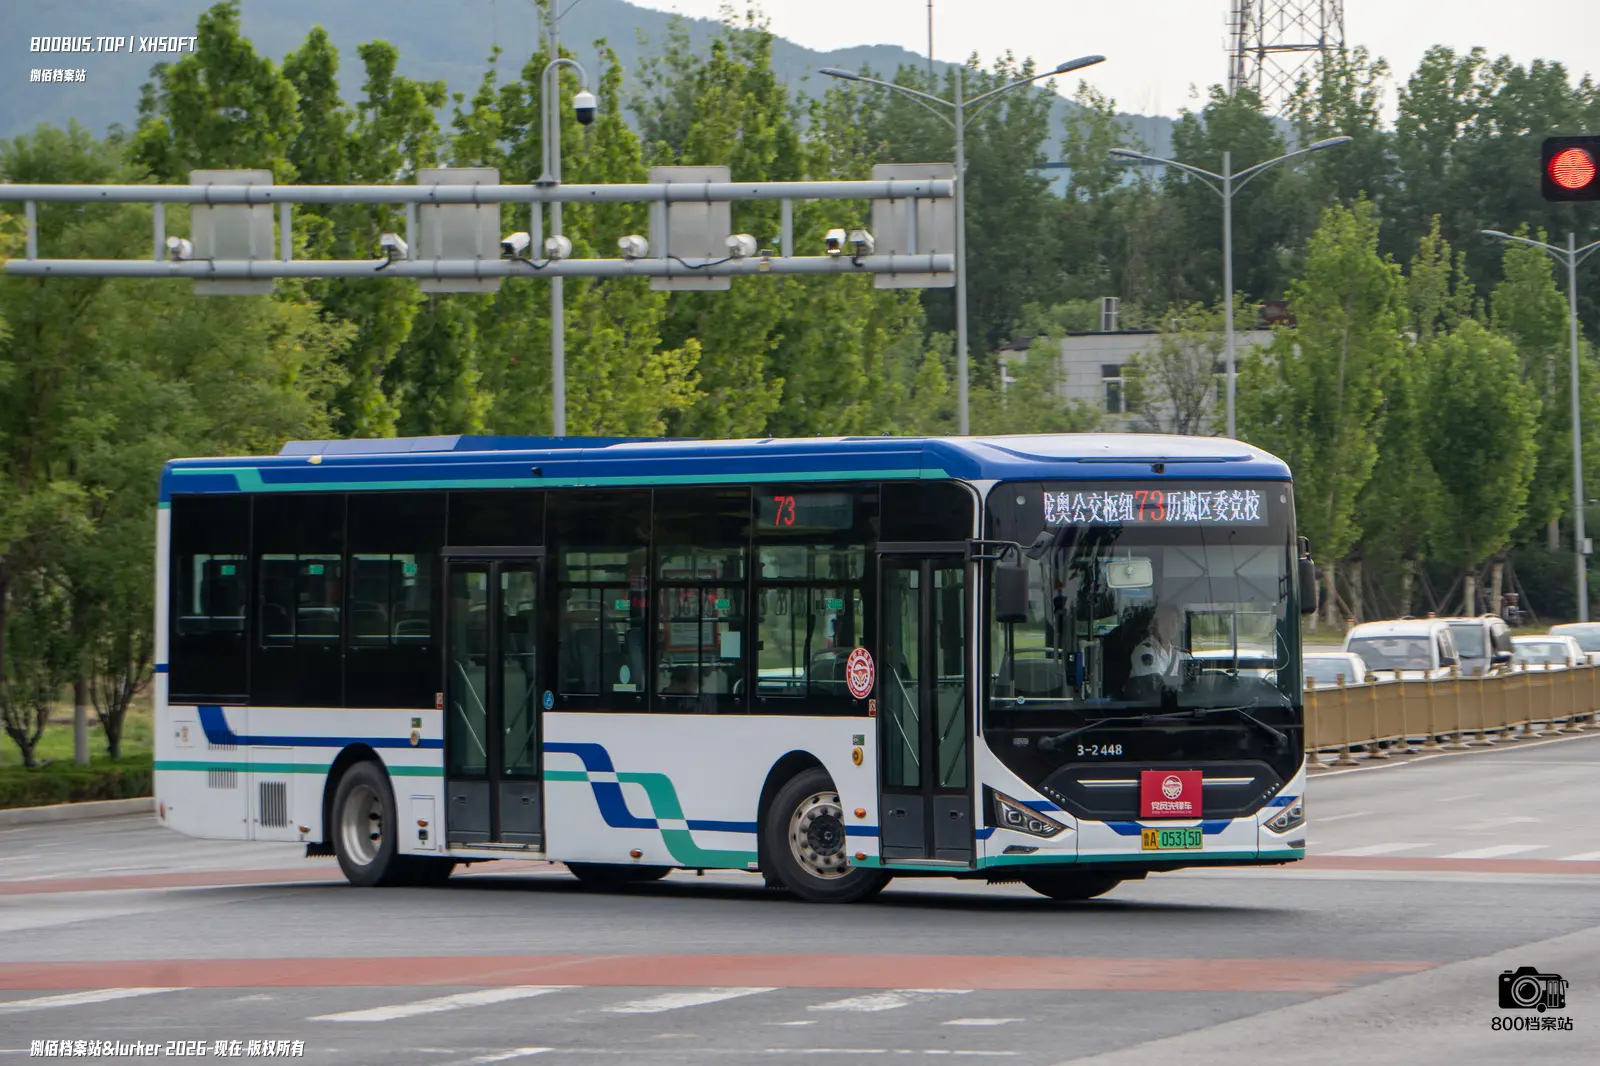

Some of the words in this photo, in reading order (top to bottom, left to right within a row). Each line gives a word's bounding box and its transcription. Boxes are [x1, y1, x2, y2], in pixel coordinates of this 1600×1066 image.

[774, 496, 796, 526] 73
[1134, 490, 1166, 521] 73
[1166, 490, 1261, 522] 历城区委党校
[1077, 744, 1123, 756] 3-2448
[1161, 831, 1202, 847] 05315D
